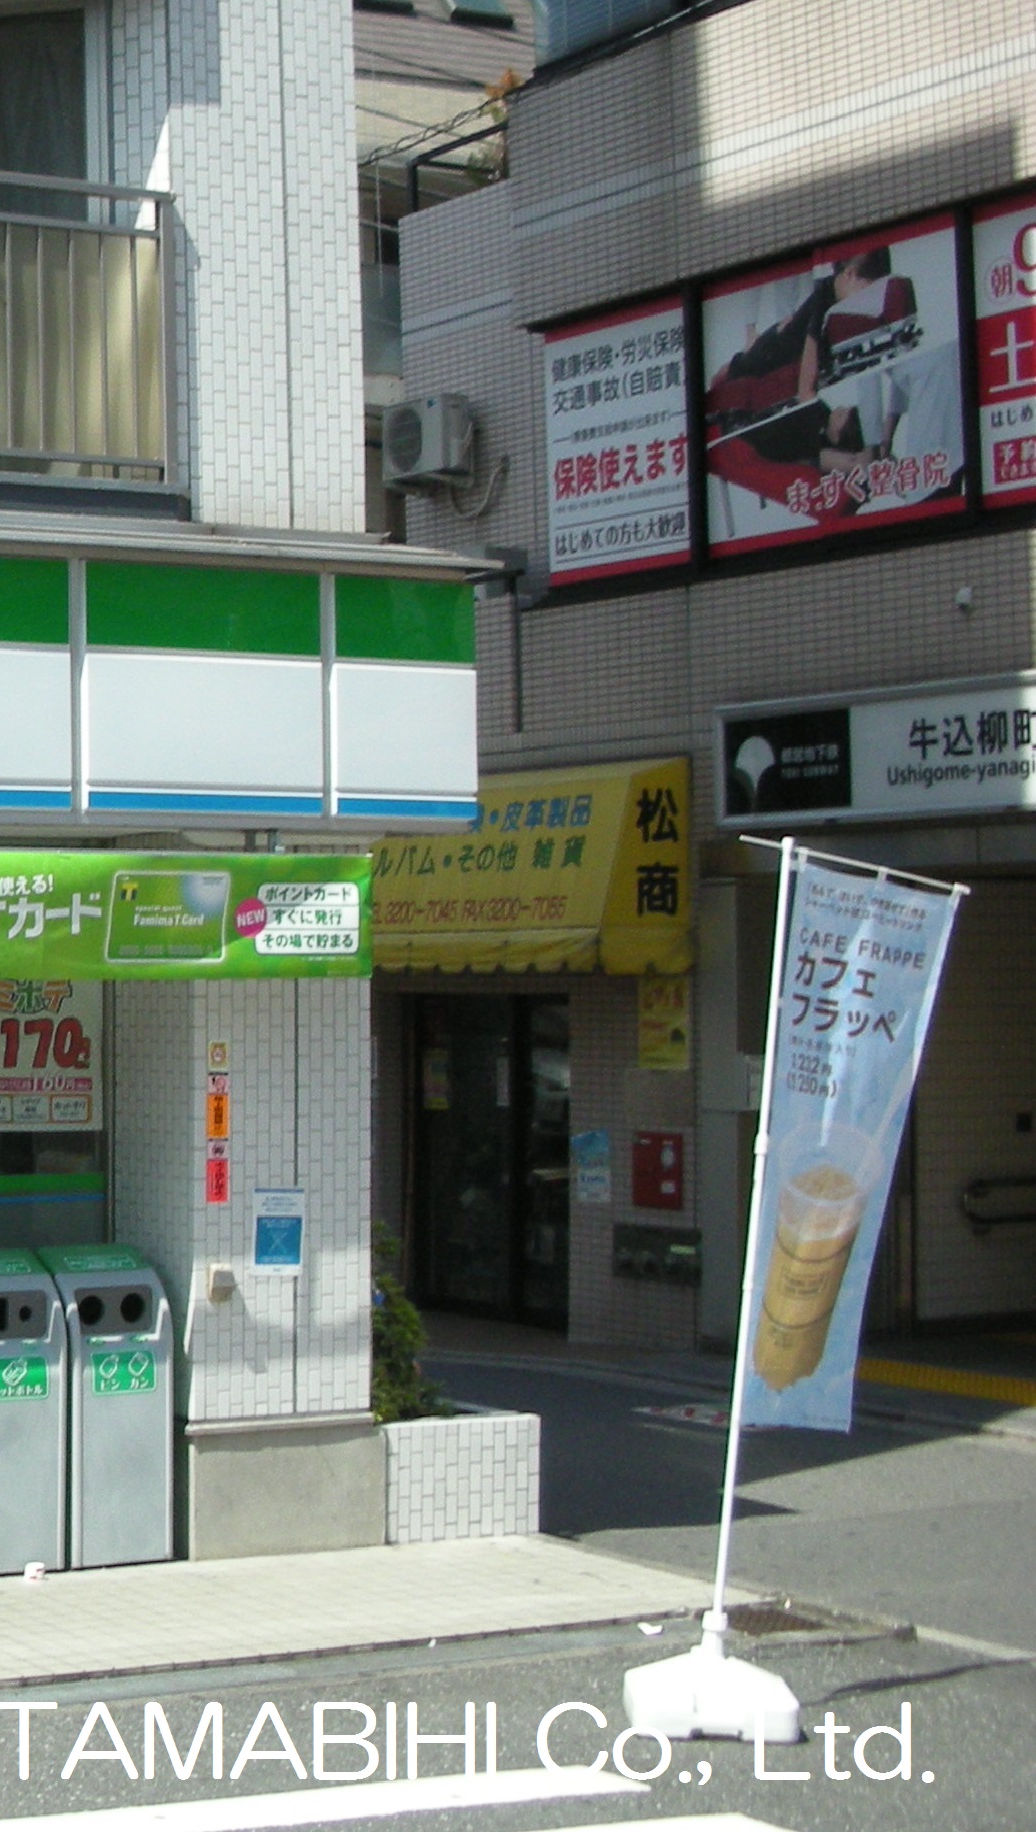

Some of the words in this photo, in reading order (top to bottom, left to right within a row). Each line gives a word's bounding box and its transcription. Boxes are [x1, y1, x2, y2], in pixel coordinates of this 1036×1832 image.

[991, 262, 1013, 297] 朝
[554, 432, 687, 500] 保険使えます
[635, 787, 680, 918] 松商
[265, 886, 352, 902] ポイントカード
[236, 908, 266, 929] NEW
[272, 908, 343, 927] すぐに発行
[263, 933, 354, 949] その場で貯まる
[799, 926, 849, 955] CAFE
[857, 938, 926, 970] FRAPPE
[794, 950, 877, 998] カフェ
[791, 993, 897, 1043] フラッペ
